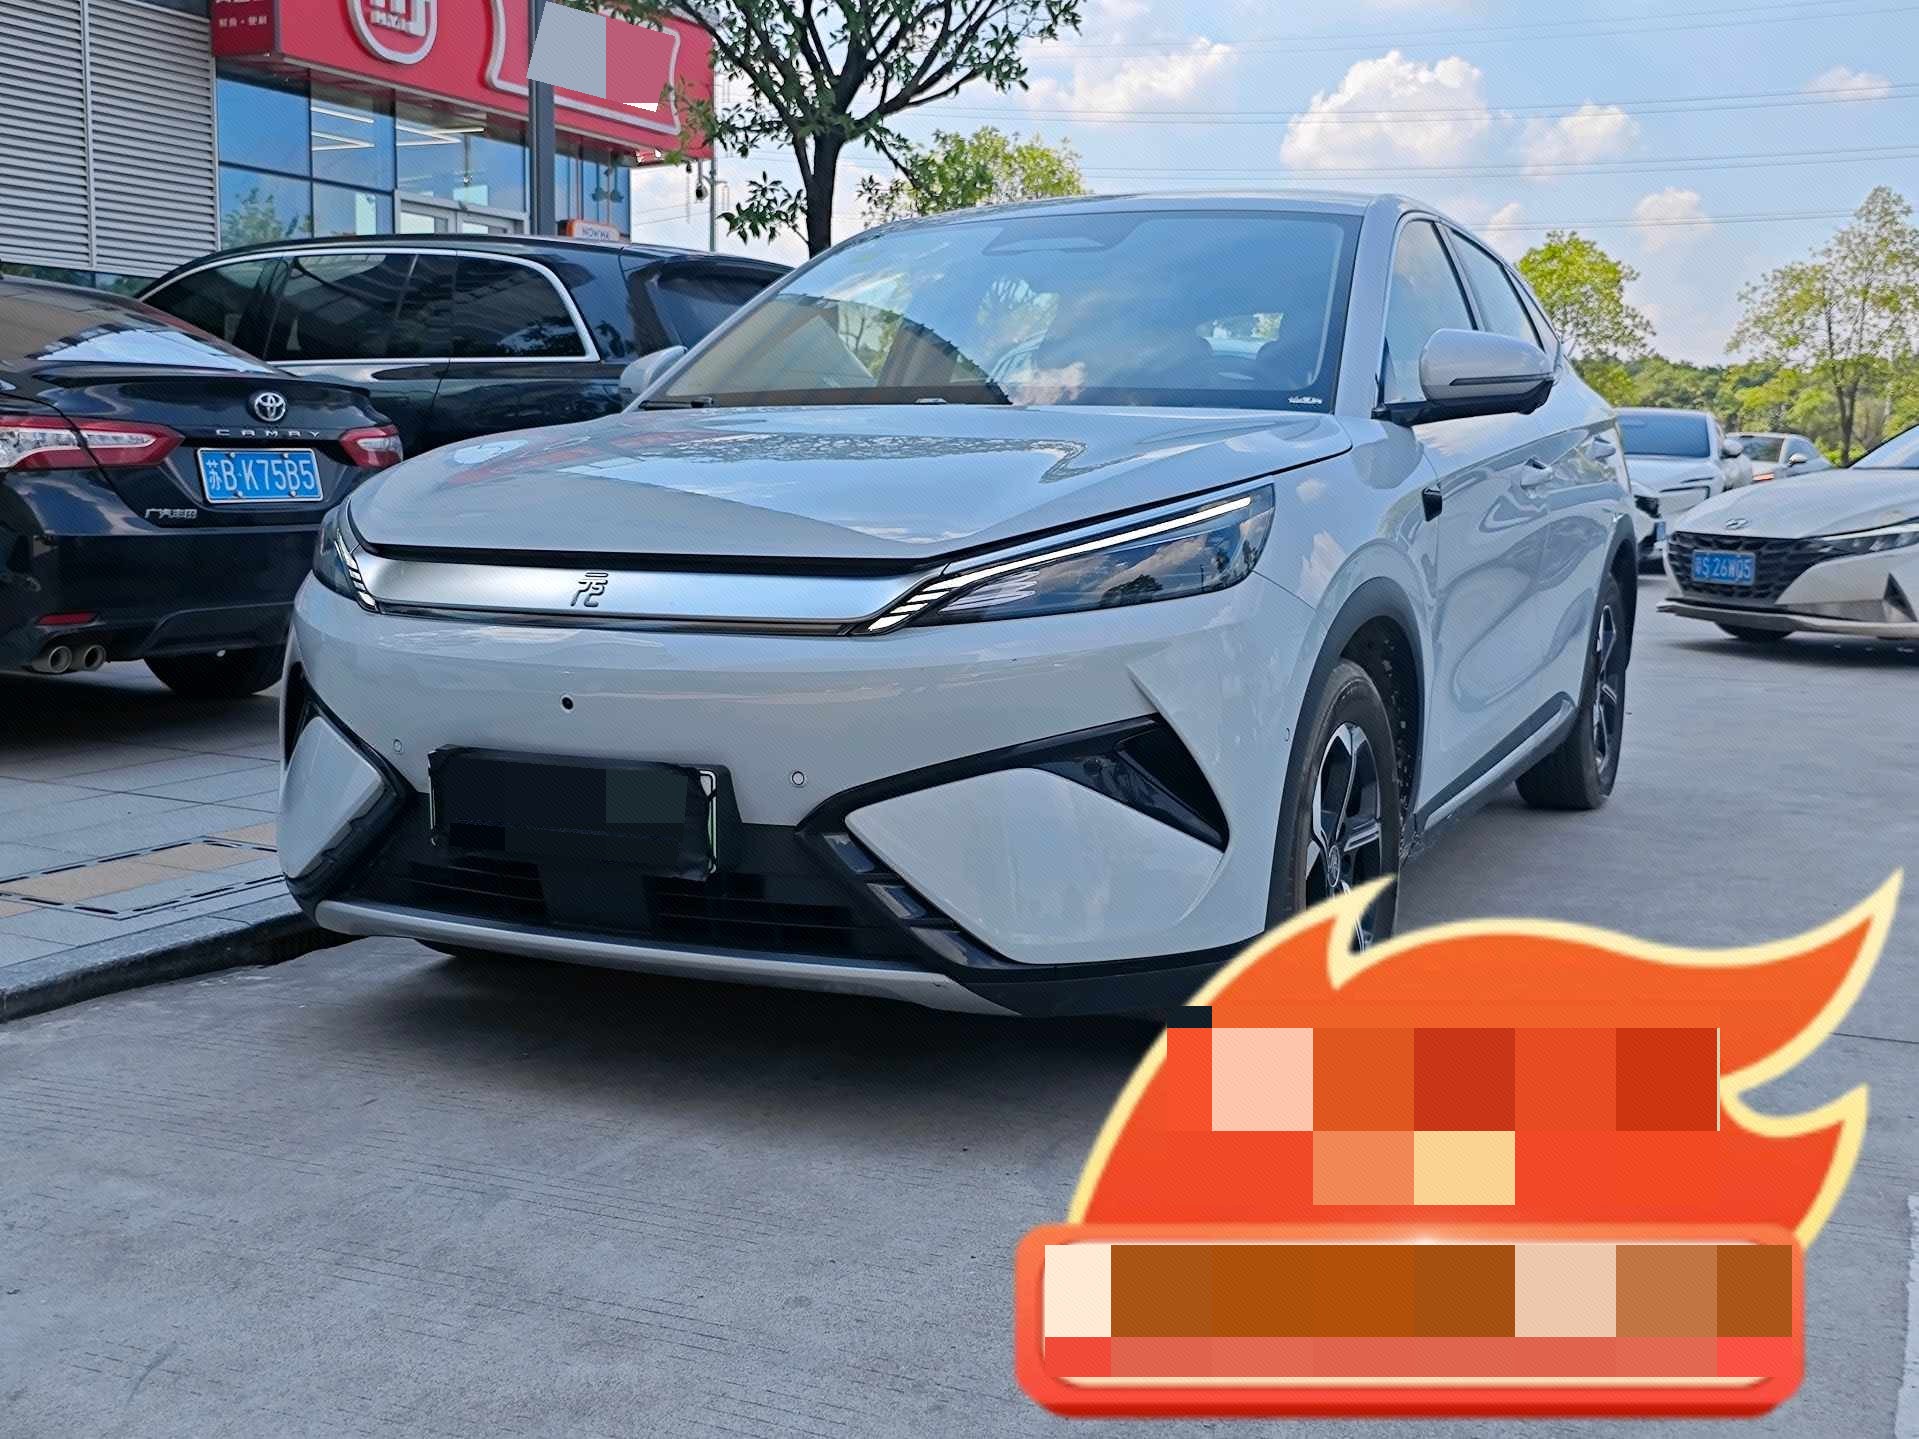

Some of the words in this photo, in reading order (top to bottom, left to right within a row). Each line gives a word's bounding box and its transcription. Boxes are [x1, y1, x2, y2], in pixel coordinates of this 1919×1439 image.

[216, 428, 320, 439] CAMRY
[144, 507, 198, 520] 广汽丰田
